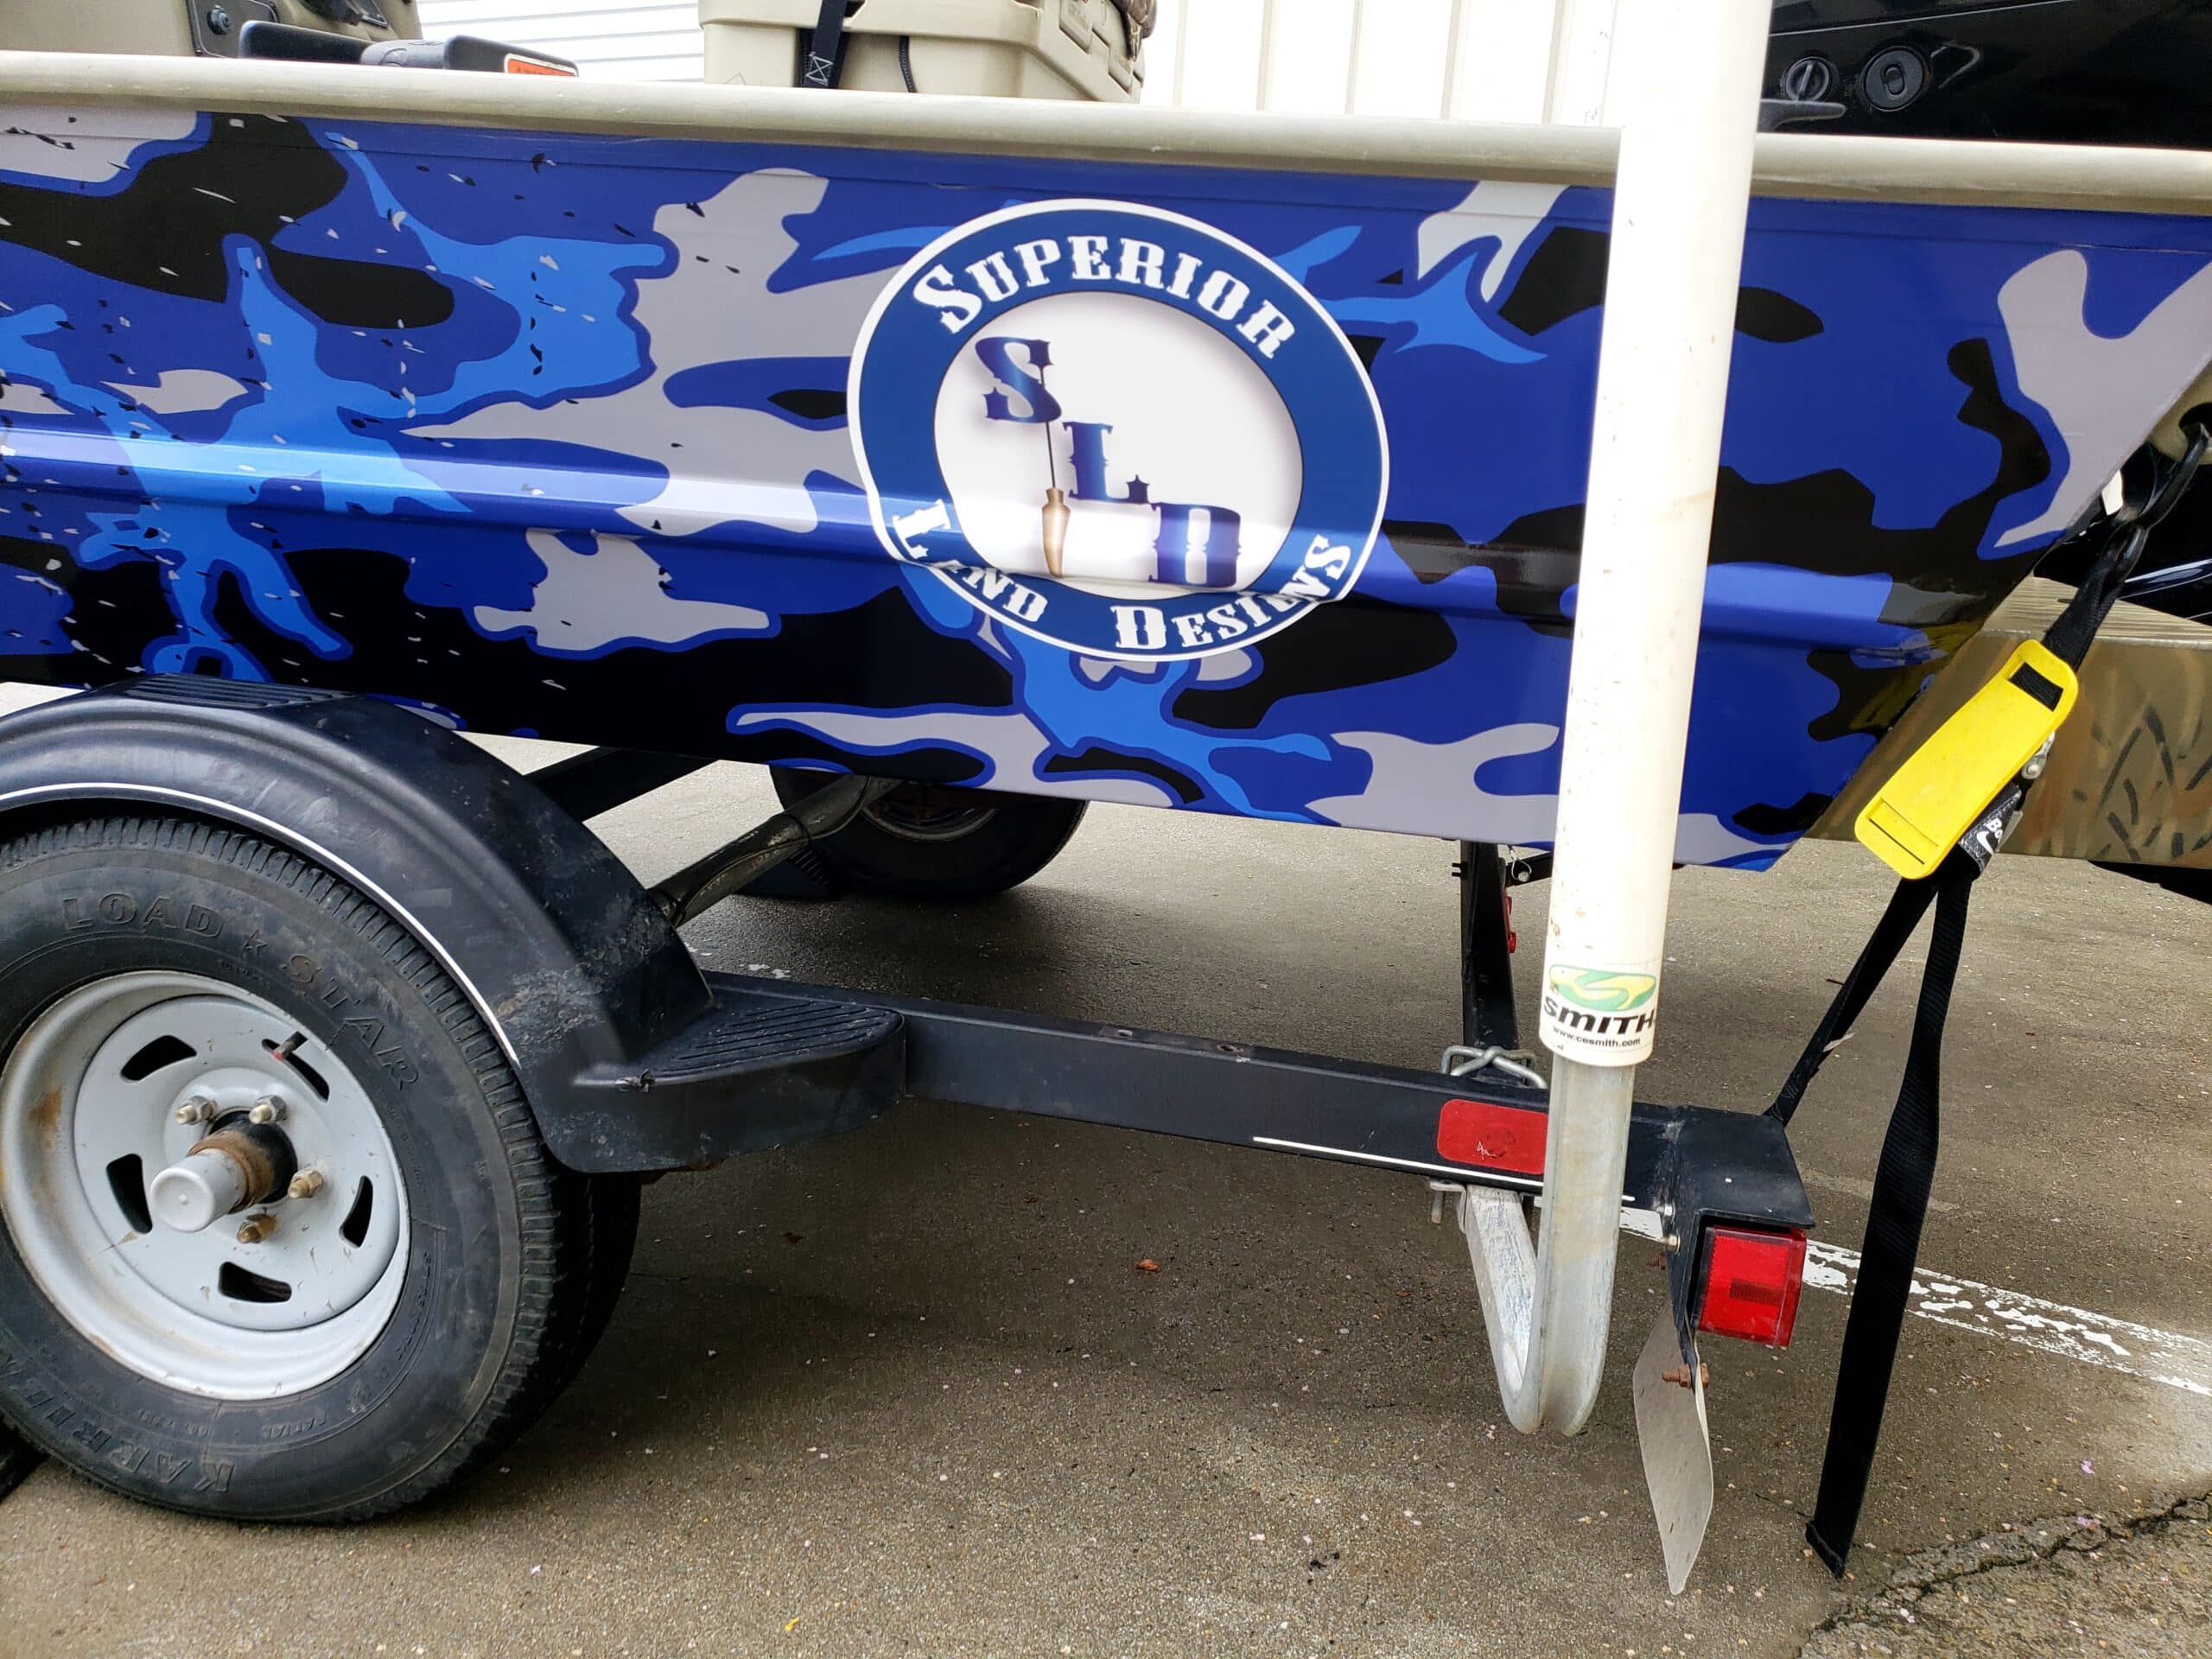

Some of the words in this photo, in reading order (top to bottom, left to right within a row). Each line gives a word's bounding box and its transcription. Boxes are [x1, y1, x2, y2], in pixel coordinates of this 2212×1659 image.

[913, 235, 1295, 360] SUPERIOR
[62, 893, 225, 938] LOAD
[280, 954, 419, 1092] STAR
[1543, 995, 1656, 1035] SMITH
[1553, 1025, 1642, 1048] www.cesmith.com
